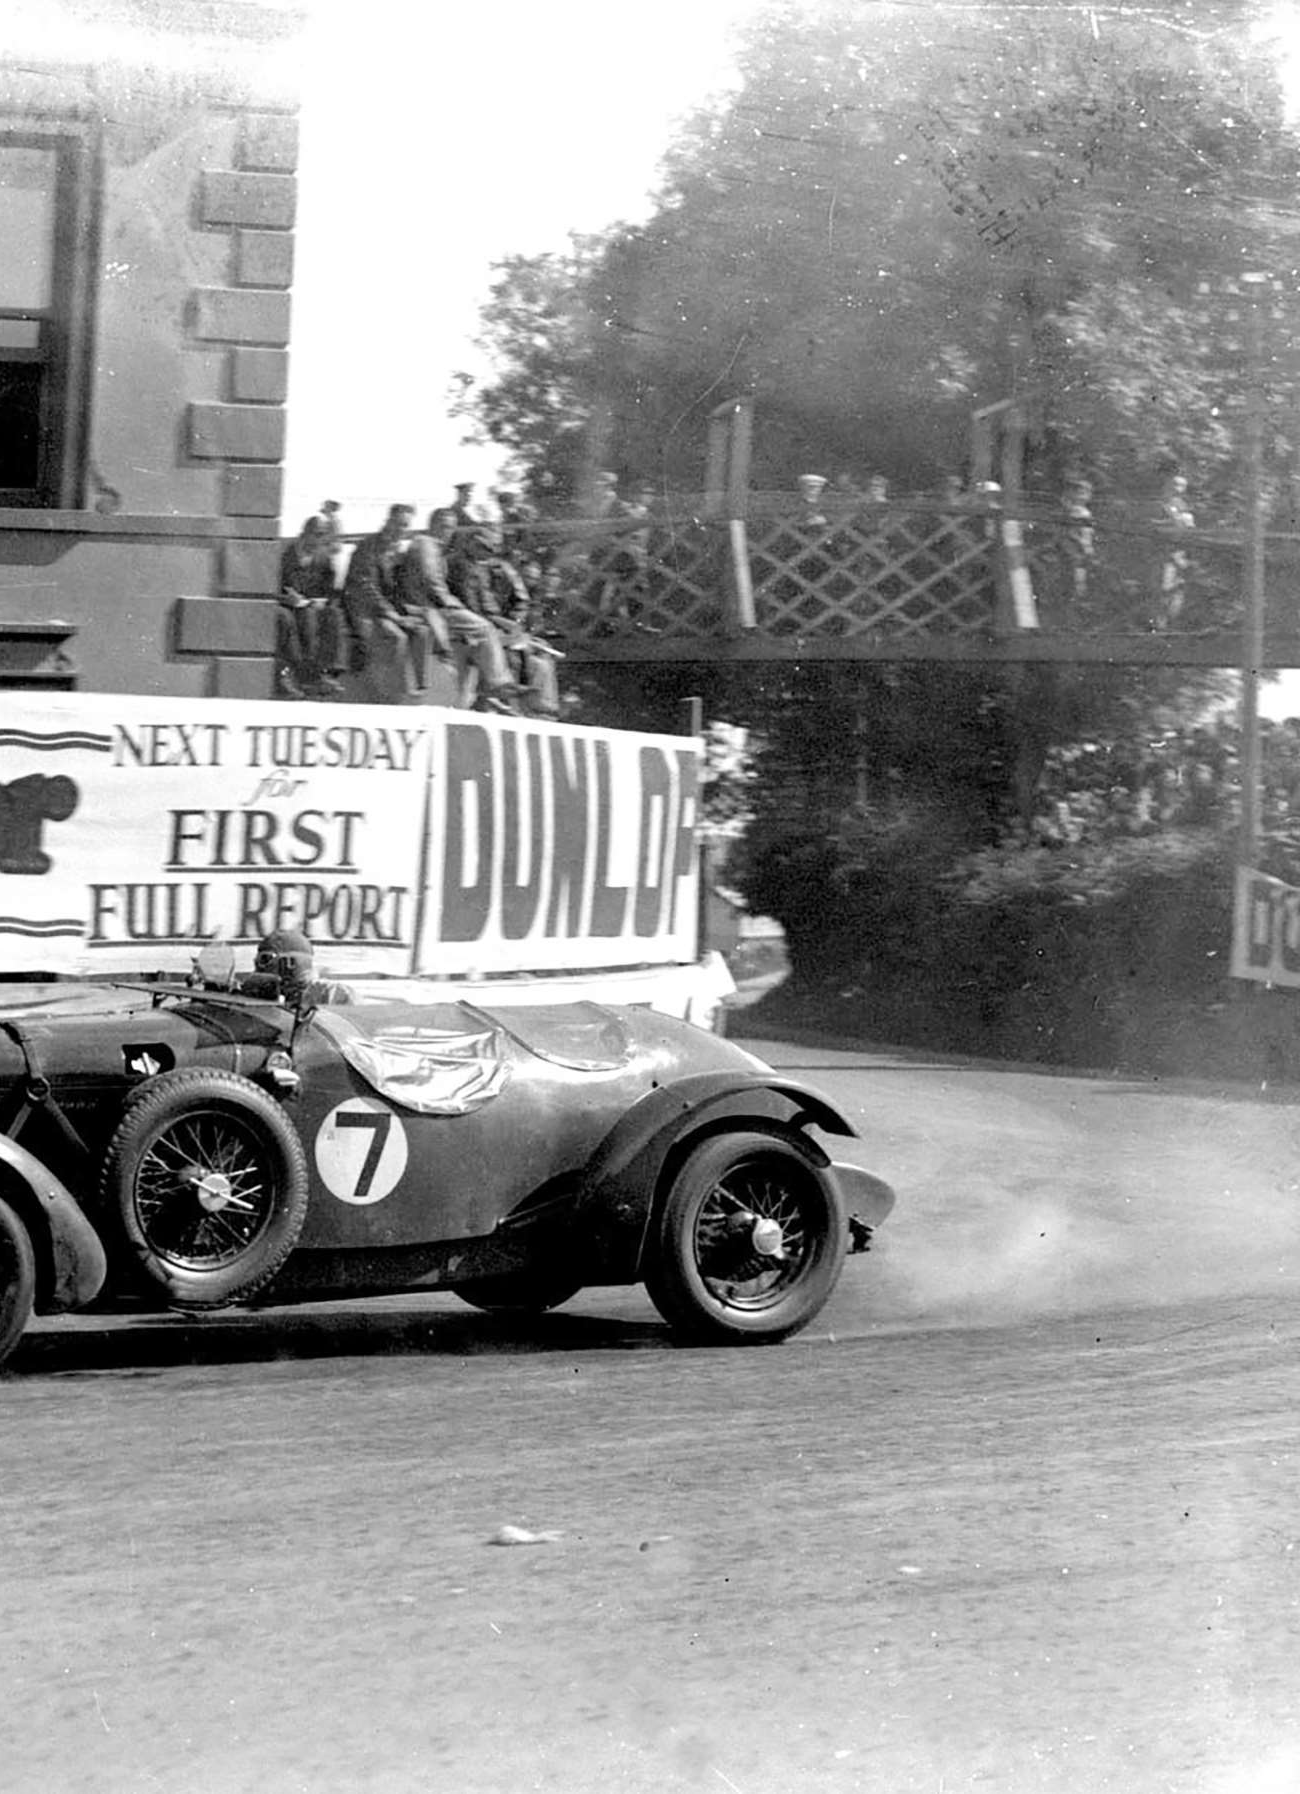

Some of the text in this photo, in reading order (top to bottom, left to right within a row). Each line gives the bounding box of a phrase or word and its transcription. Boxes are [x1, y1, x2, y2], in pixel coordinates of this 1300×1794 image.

[111, 724, 428, 772] NEXT TUESDAY
[240, 769, 309, 806] for
[163, 809, 367, 867] FIRST
[438, 723, 696, 944] DUNLOP
[86, 882, 410, 941] FULL REPORT
[334, 1112, 392, 1197] 7
